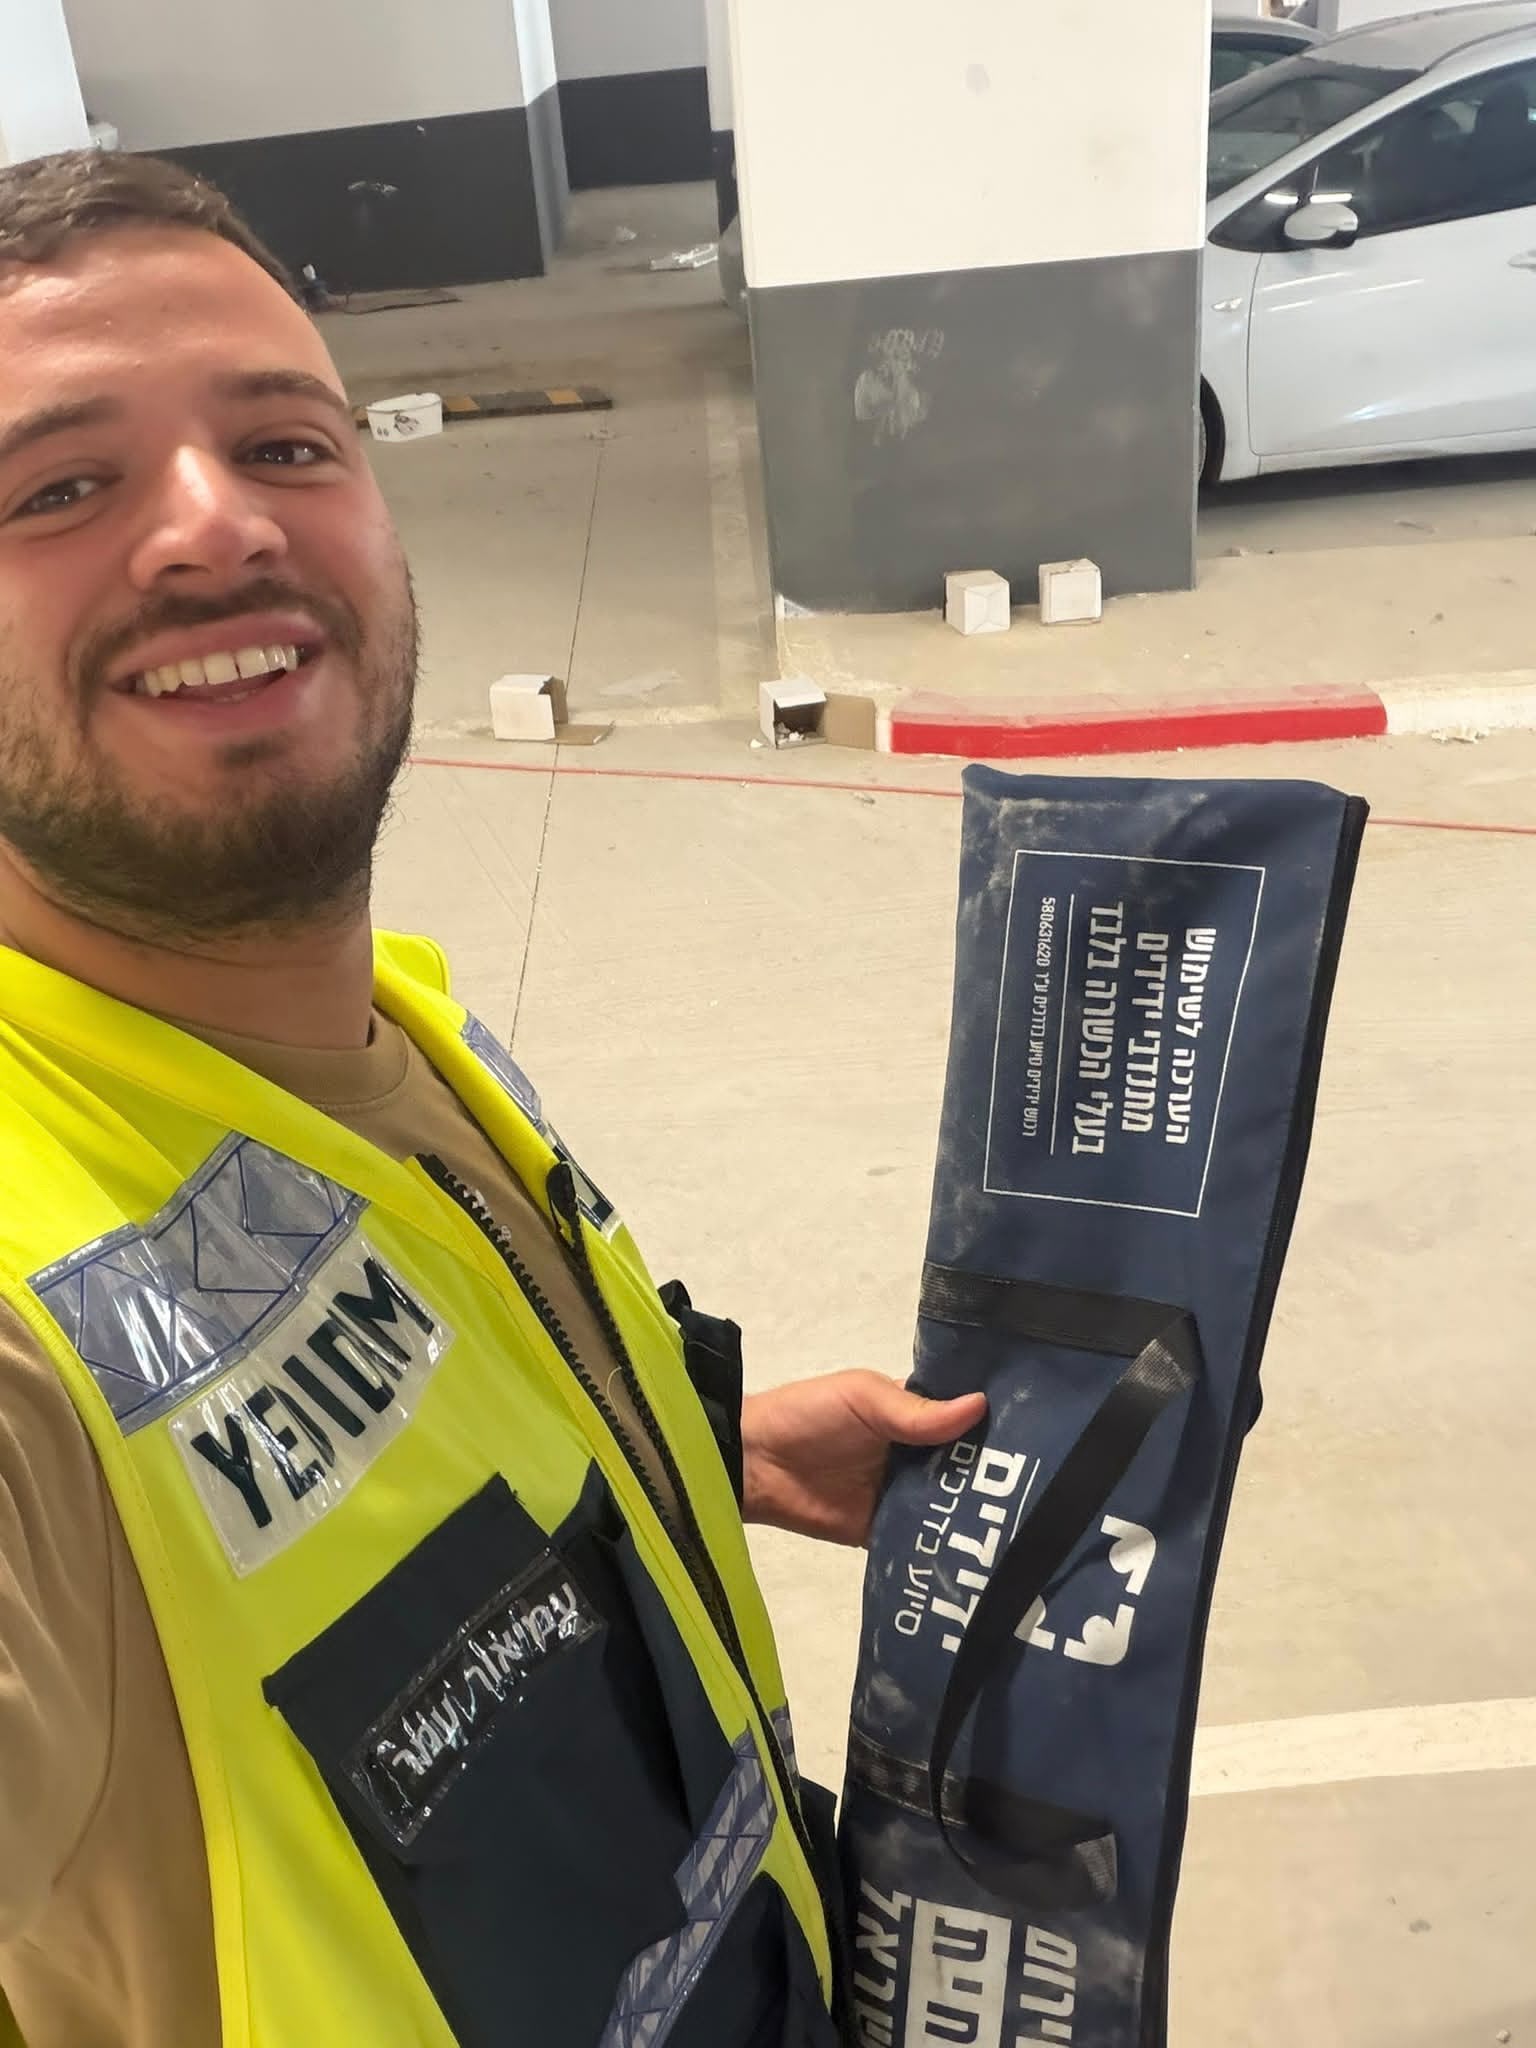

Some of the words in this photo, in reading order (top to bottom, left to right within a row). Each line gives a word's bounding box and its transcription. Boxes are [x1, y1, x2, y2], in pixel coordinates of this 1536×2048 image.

[1036, 897, 1056, 967] 580631620
[1087, 901, 1127, 970] בלבד
[1131, 931, 1169, 1020] ידידים
[1175, 927, 1217, 1039] לשימוש
[1028, 1041, 1045, 1067] סיוע
[1030, 996, 1048, 1038] בדרכים
[1079, 979, 1118, 1080] הכשרה
[1026, 1070, 1042, 1105] ידידים
[1121, 1030, 1162, 1133] מתנדבי
[1165, 1048, 1196, 1145] הערכה
[1022, 1107, 1040, 1138] רכוש
[1072, 1091, 1114, 1154] בעלי
[894, 1563, 933, 1636] סיוע
[914, 1441, 978, 1555] בדרכים
[1014, 1924, 1078, 2048] ירום
